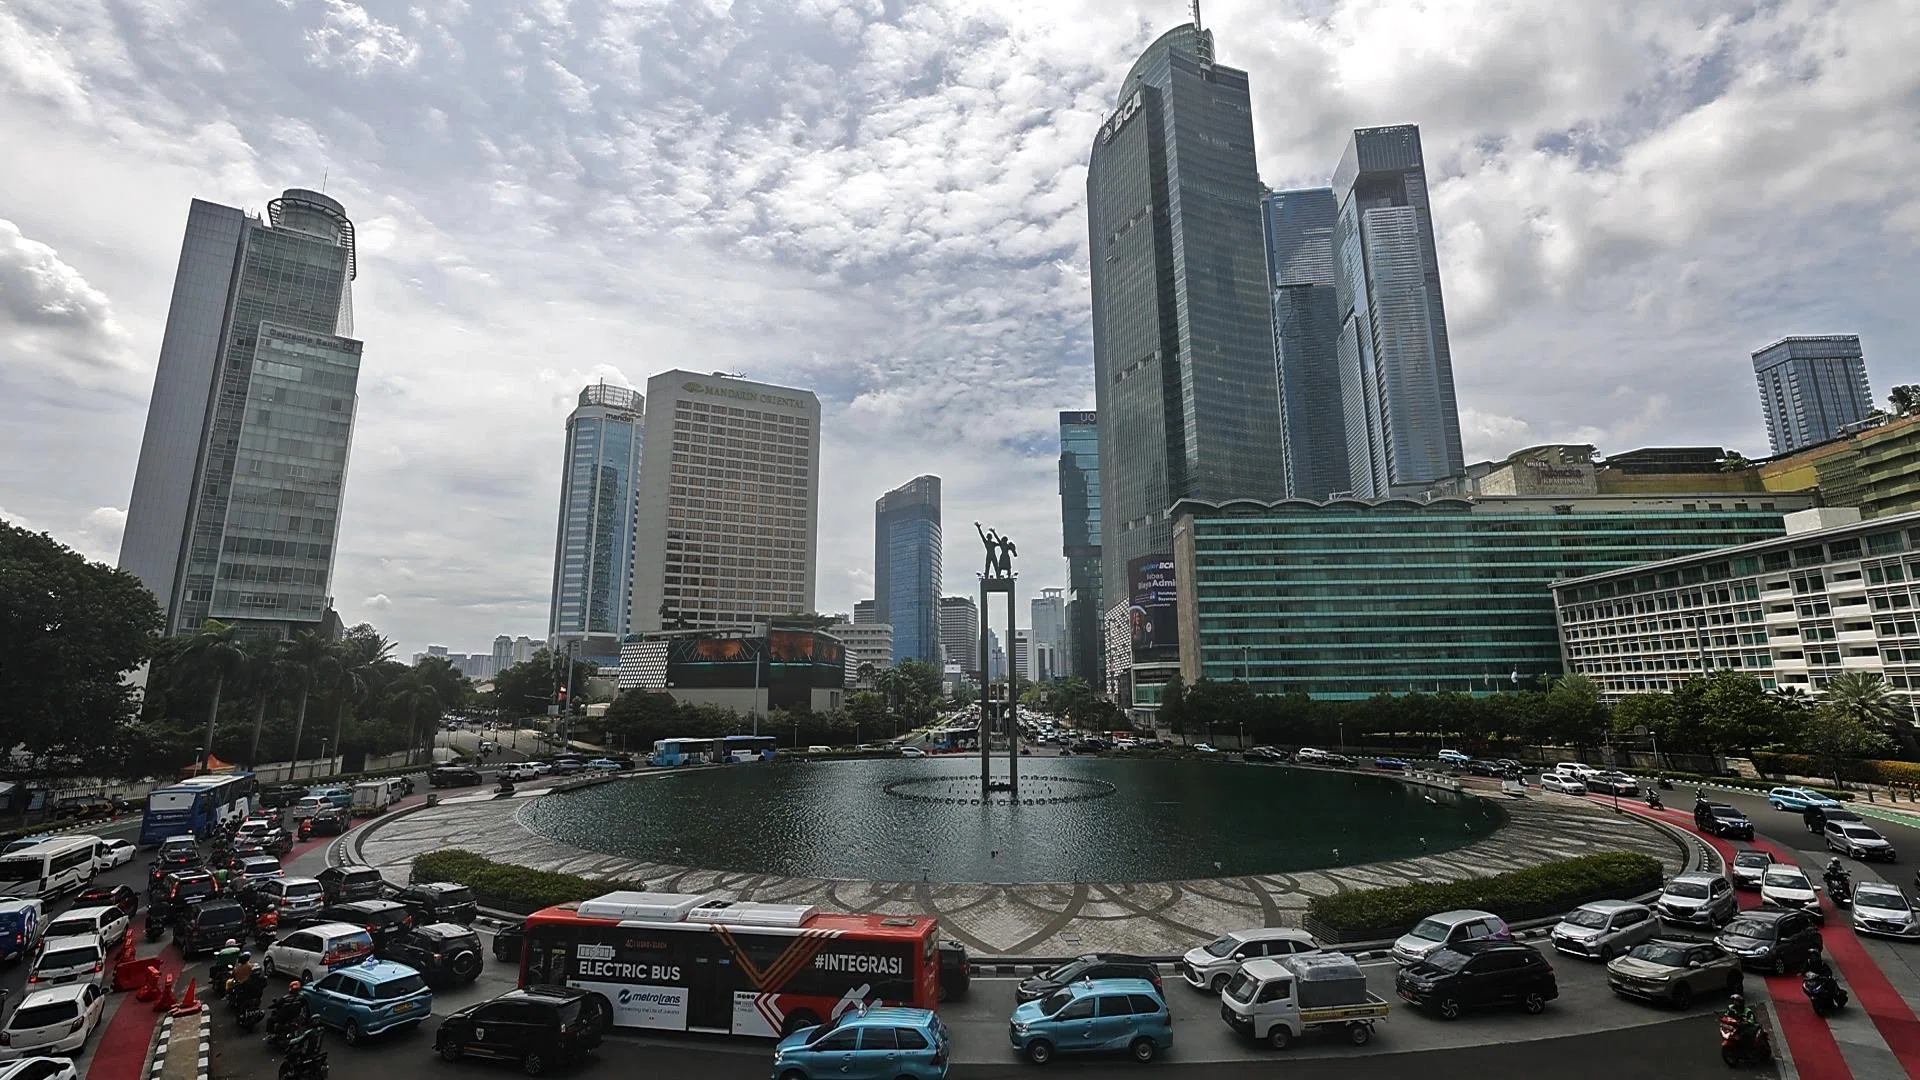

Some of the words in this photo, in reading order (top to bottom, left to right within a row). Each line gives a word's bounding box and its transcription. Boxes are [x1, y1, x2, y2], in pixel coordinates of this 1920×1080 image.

[1114, 90, 1141, 132] BCA
[705, 385, 757, 401] MANDARIN
[760, 393, 806, 409] ORIENTAL
[579, 960, 648, 979] ELECTRIC
[651, 965, 681, 981] BUS
[814, 954, 902, 974] #INTEGRASI
[632, 991, 681, 1006] metrotrans
